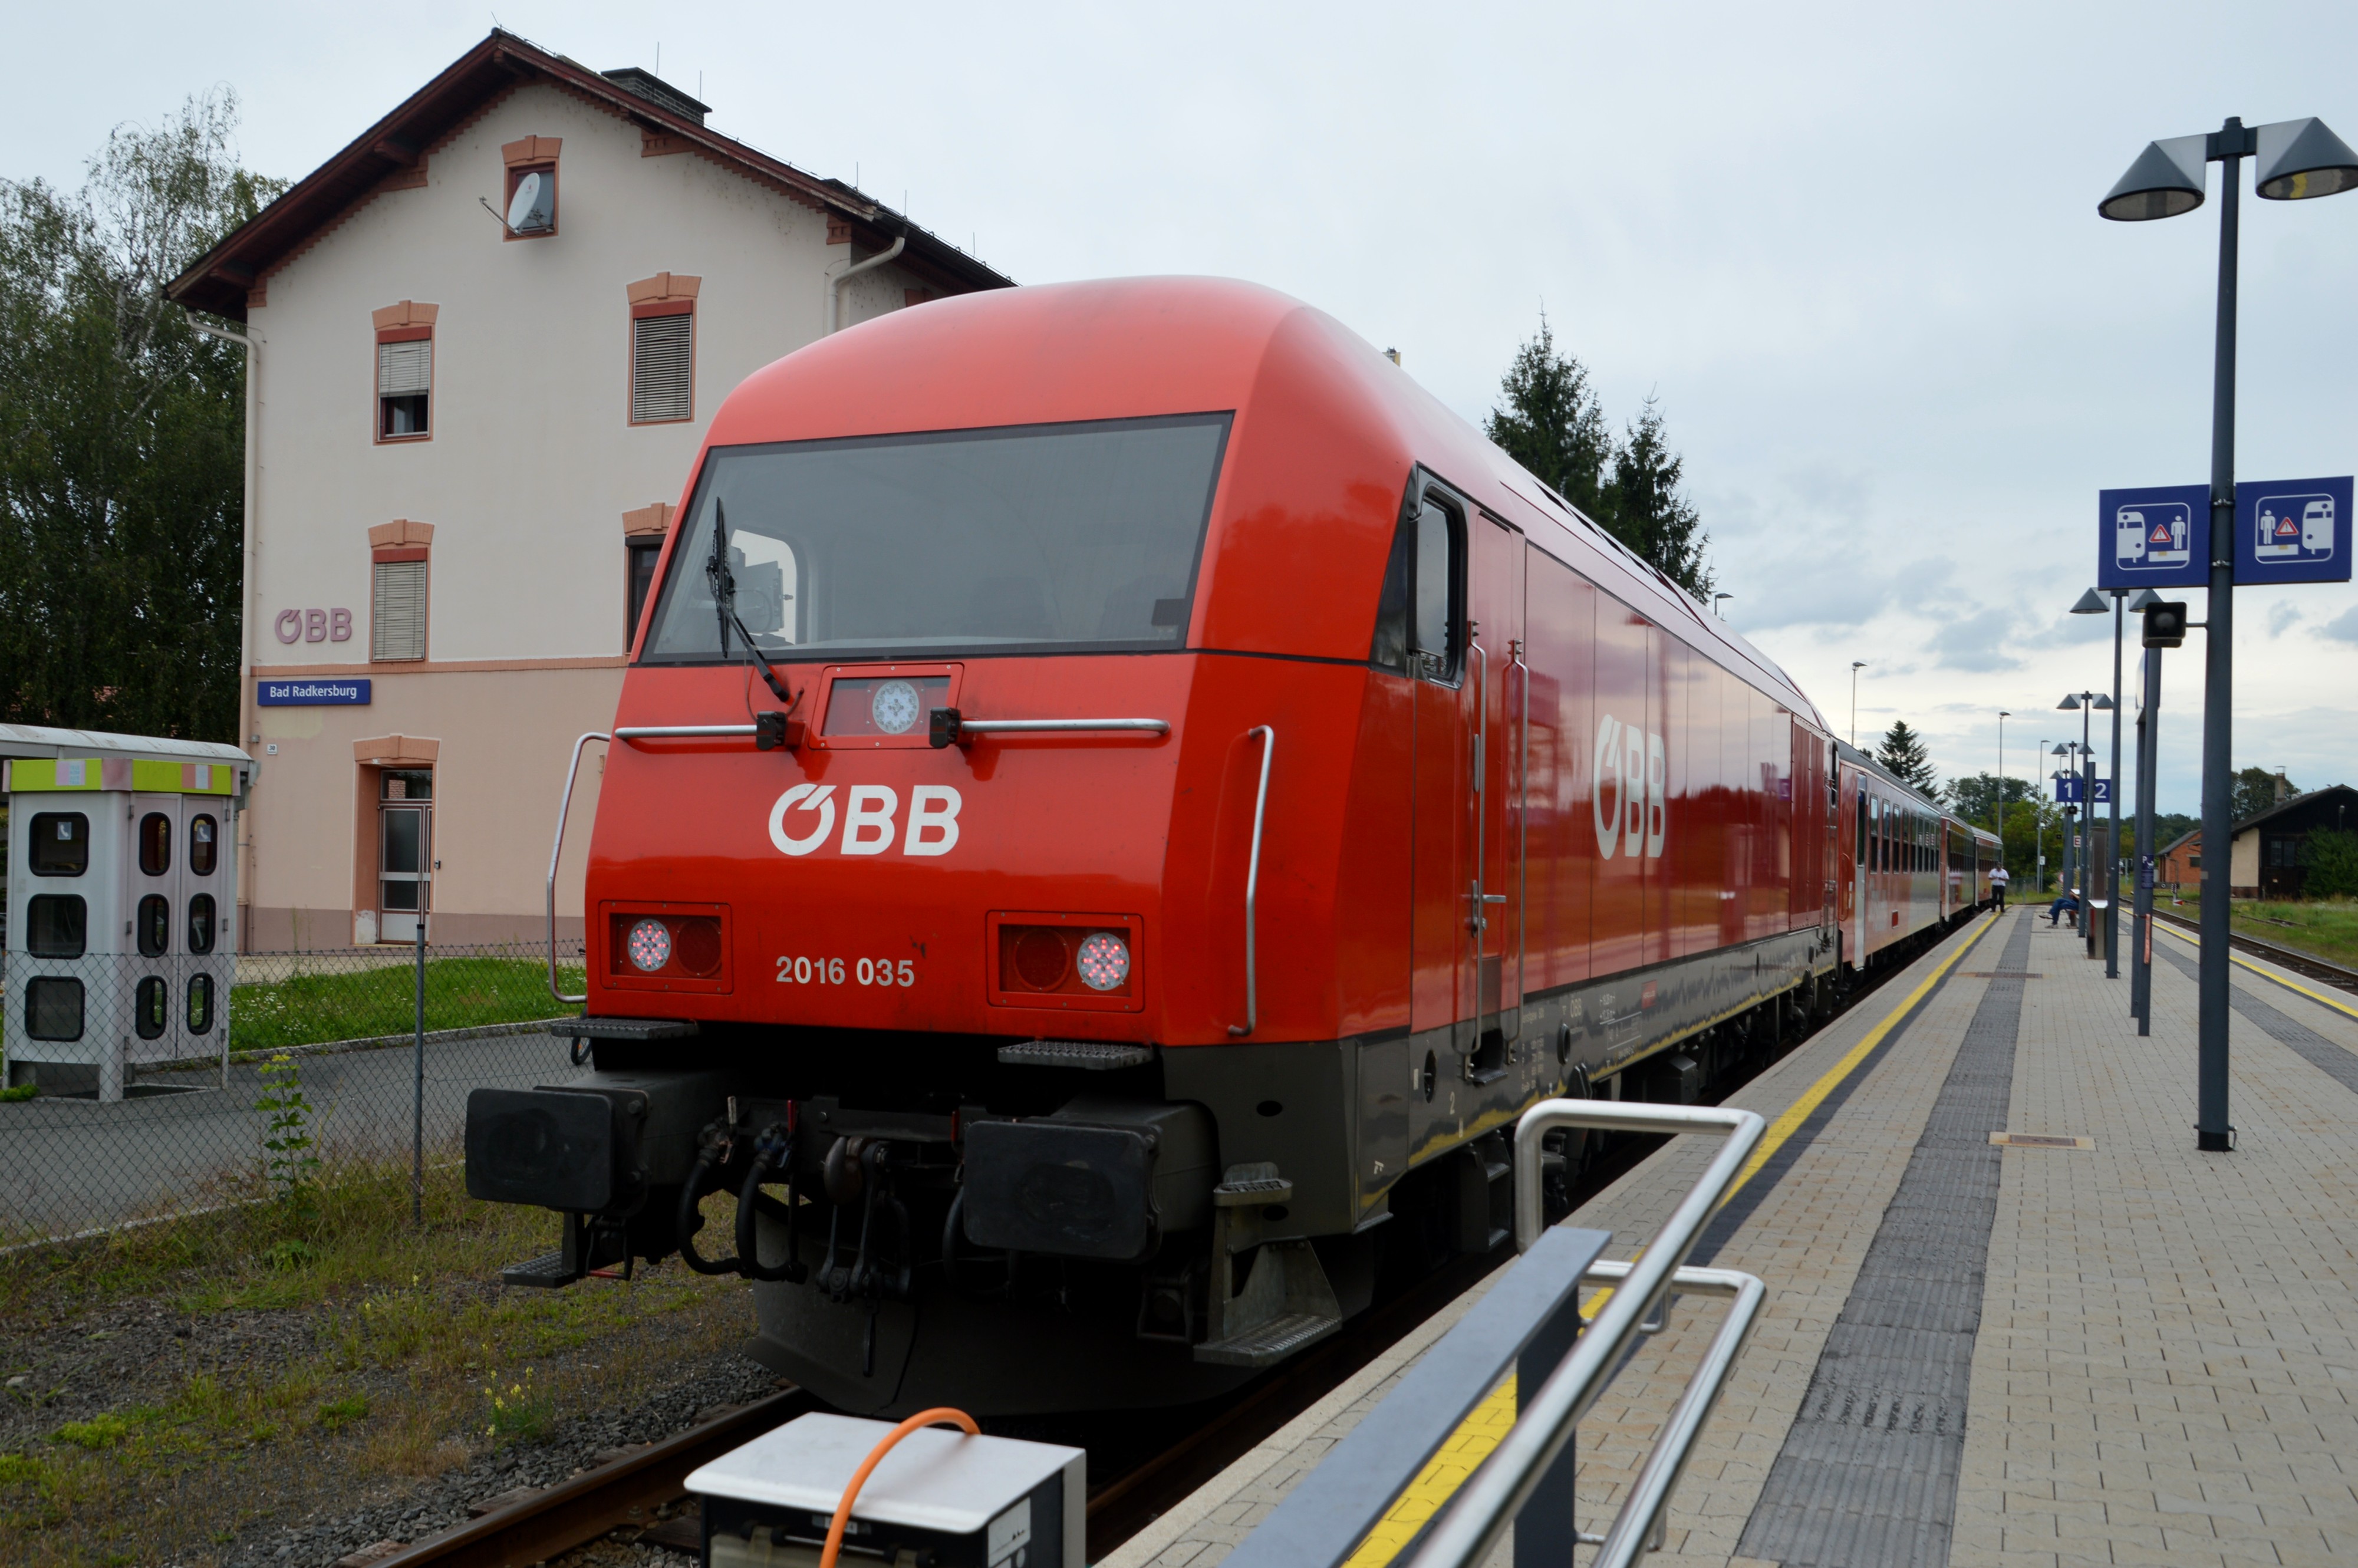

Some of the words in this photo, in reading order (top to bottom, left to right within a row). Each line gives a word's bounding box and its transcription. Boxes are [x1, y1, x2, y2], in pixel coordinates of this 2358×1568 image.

[275, 608, 352, 644] ÖBB
[269, 686, 289, 697] Bad
[292, 684, 357, 699] Radkersburg
[1593, 714, 1666, 860] ÖBB
[2064, 782, 2072, 798] 1
[2094, 782, 2107, 799] 2
[768, 783, 962, 856] ÖBB
[2142, 855, 2148, 864] P
[776, 956, 845, 984] 2016
[856, 957, 915, 987] 035
[1450, 1091, 1455, 1115] 2
